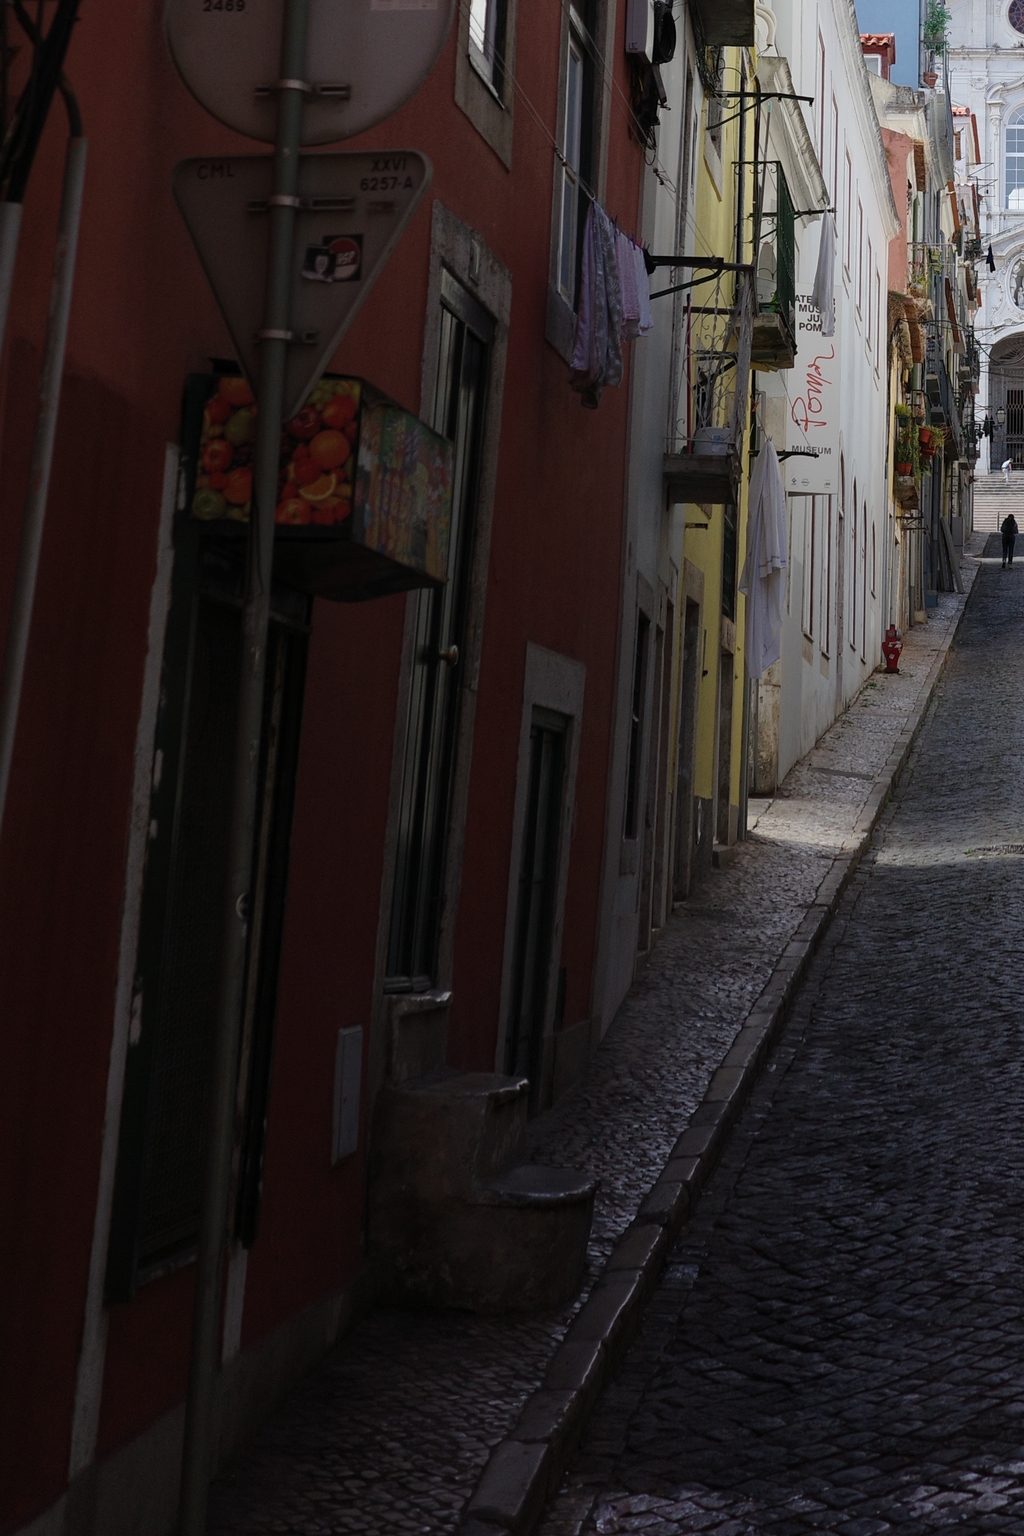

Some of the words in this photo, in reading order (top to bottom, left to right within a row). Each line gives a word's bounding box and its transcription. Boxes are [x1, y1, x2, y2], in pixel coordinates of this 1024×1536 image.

[203, 0, 245, 11] 2469
[197, 164, 234, 180] CML
[371, 157, 407, 173] XXVI
[360, 176, 413, 191] 6257-A
[791, 445, 832, 455] MUSEUM
